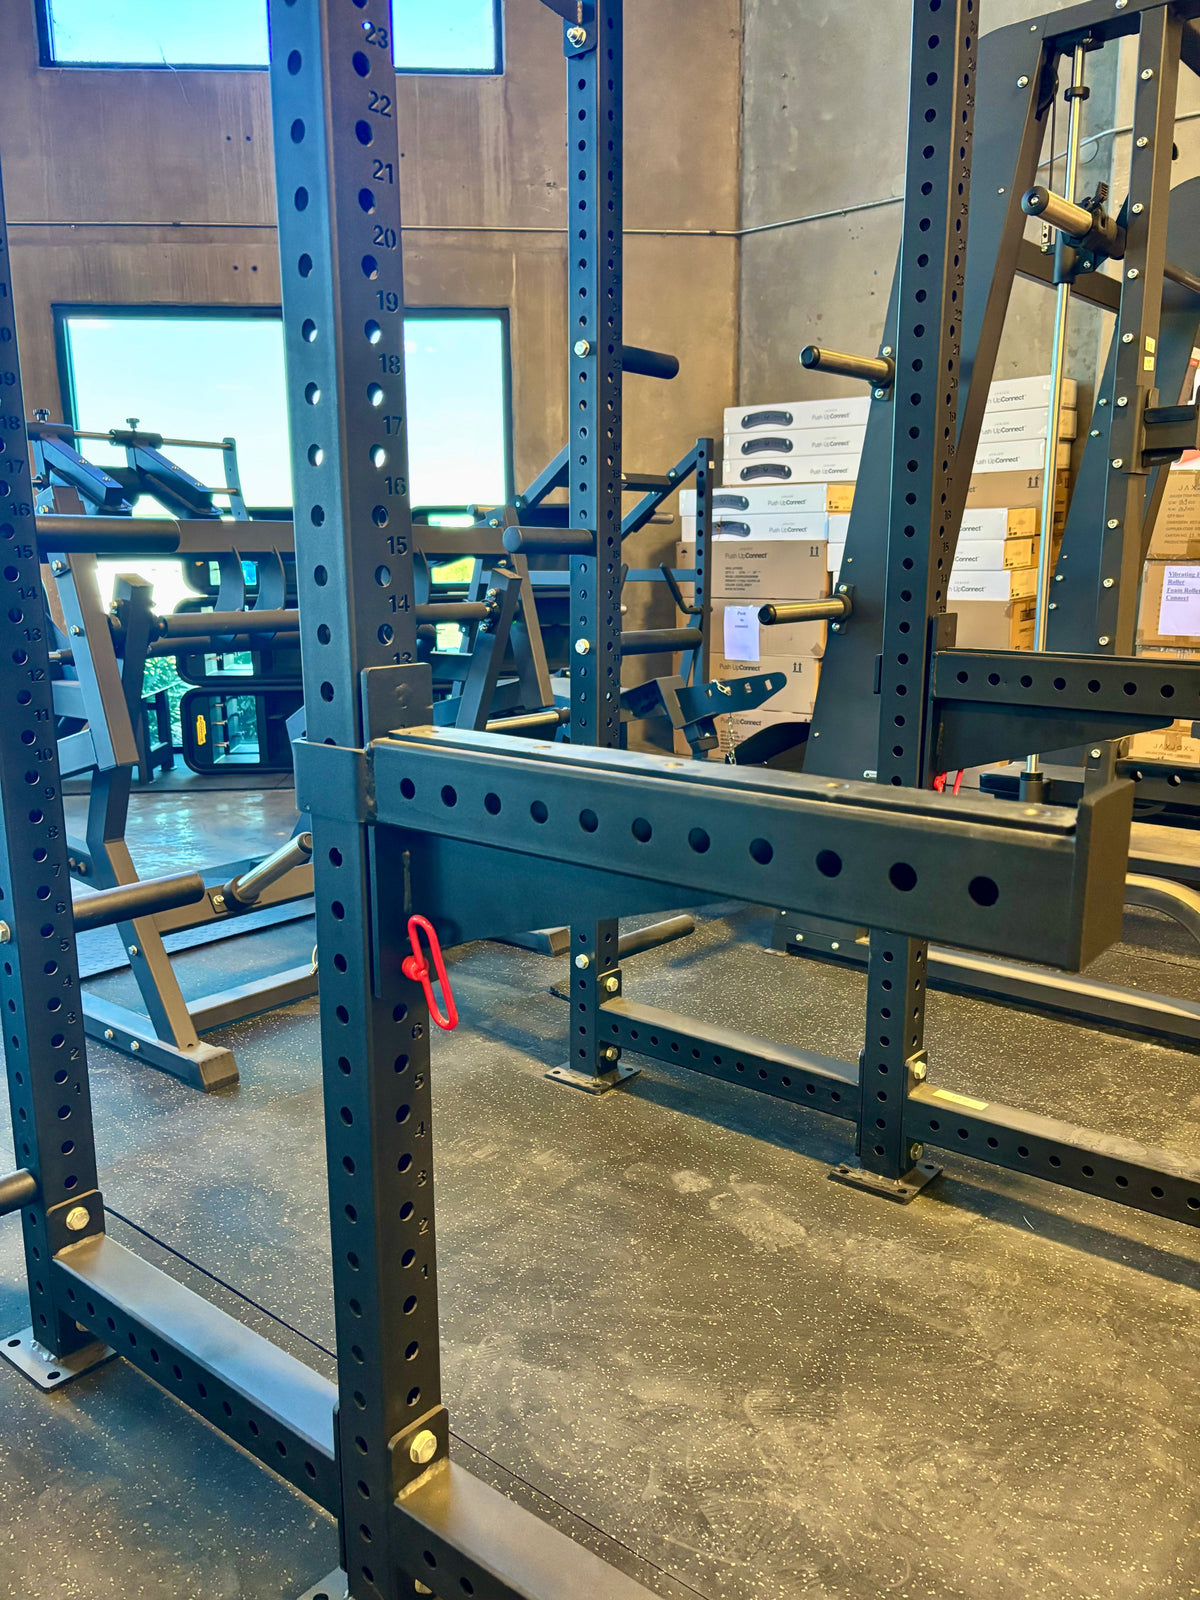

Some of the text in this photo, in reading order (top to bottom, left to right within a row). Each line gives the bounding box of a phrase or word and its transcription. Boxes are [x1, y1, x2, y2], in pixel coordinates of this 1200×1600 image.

[365, 22, 388, 49] 23
[368, 90, 391, 118] 22
[373, 159, 393, 184] 21
[373, 225, 396, 250] 20
[0, 282, 8, 298] 1
[376, 290, 398, 313] 19
[0, 327, 12, 342] 0
[378, 353, 400, 375] 18
[0, 416, 21, 431] 18
[383, 415, 402, 435] 17
[6, 459, 24, 474] 17
[385, 476, 406, 496] 16
[10, 503, 31, 517] 16
[14, 545, 34, 559] 15
[386, 536, 408, 555] 15
[17, 586, 38, 600] 14
[389, 594, 410, 613] 14
[23, 627, 42, 641] 13
[27, 668, 46, 682] 12
[33, 708, 50, 722] 11
[34, 748, 53, 761] 10
[44, 786, 56, 800] 9
[47, 825, 59, 839] 8
[52, 863, 62, 877] 7
[55, 902, 66, 914] 6
[60, 939, 70, 951] 5
[62, 974, 73, 987] 4
[67, 1011, 77, 1024] 3
[411, 1022, 423, 1040] 6
[69, 1048, 80, 1061] 2
[73, 1082, 81, 1095] 1
[414, 1072, 424, 1090] 5
[414, 1120, 426, 1138] 4
[417, 1169, 427, 1187] 3
[419, 1217, 429, 1235] 2
[421, 1264, 428, 1280] 1
